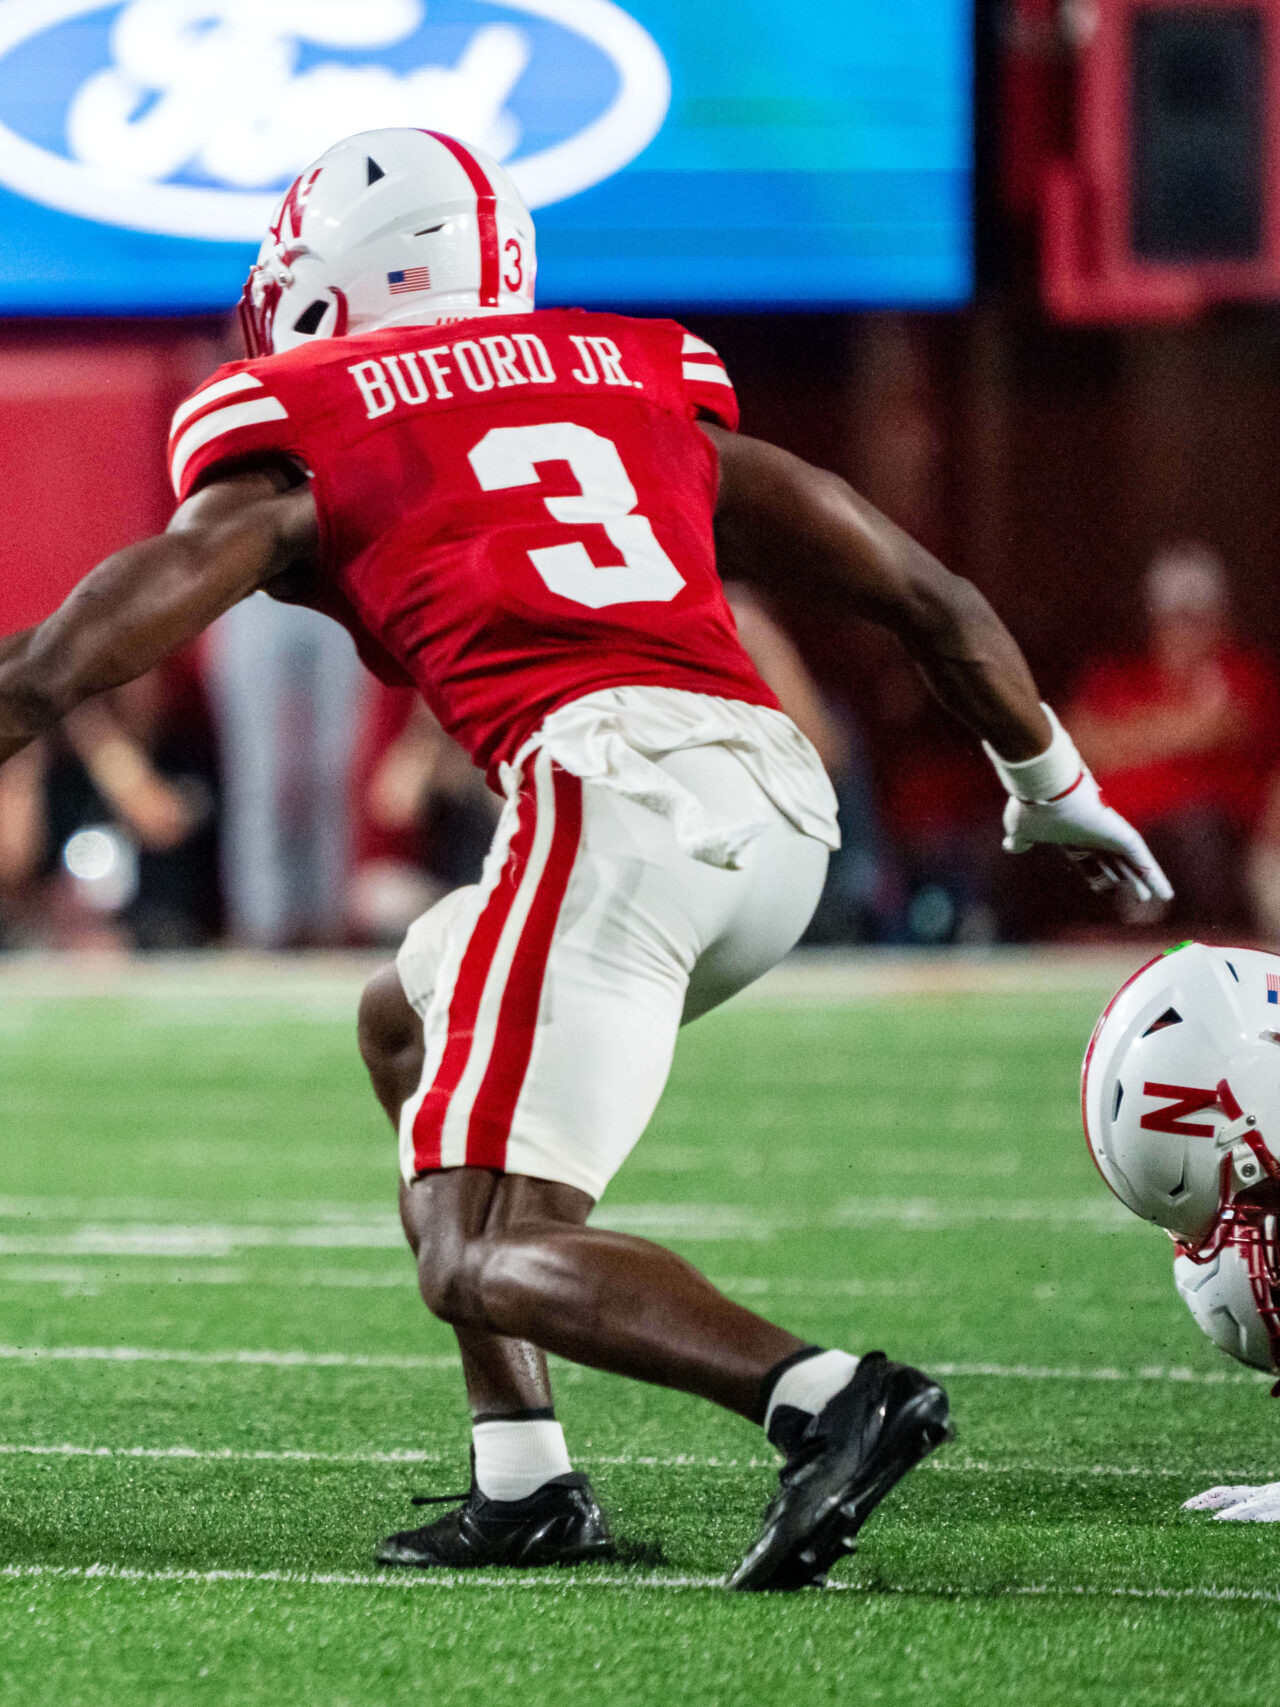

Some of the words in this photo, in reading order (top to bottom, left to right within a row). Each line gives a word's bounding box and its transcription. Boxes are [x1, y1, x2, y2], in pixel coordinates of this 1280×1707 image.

[503, 238, 523, 292] 3
[348, 333, 557, 420] BUFORD
[569, 335, 644, 390] JR.
[467, 421, 687, 610] 3
[1139, 1080, 1219, 1138] N
